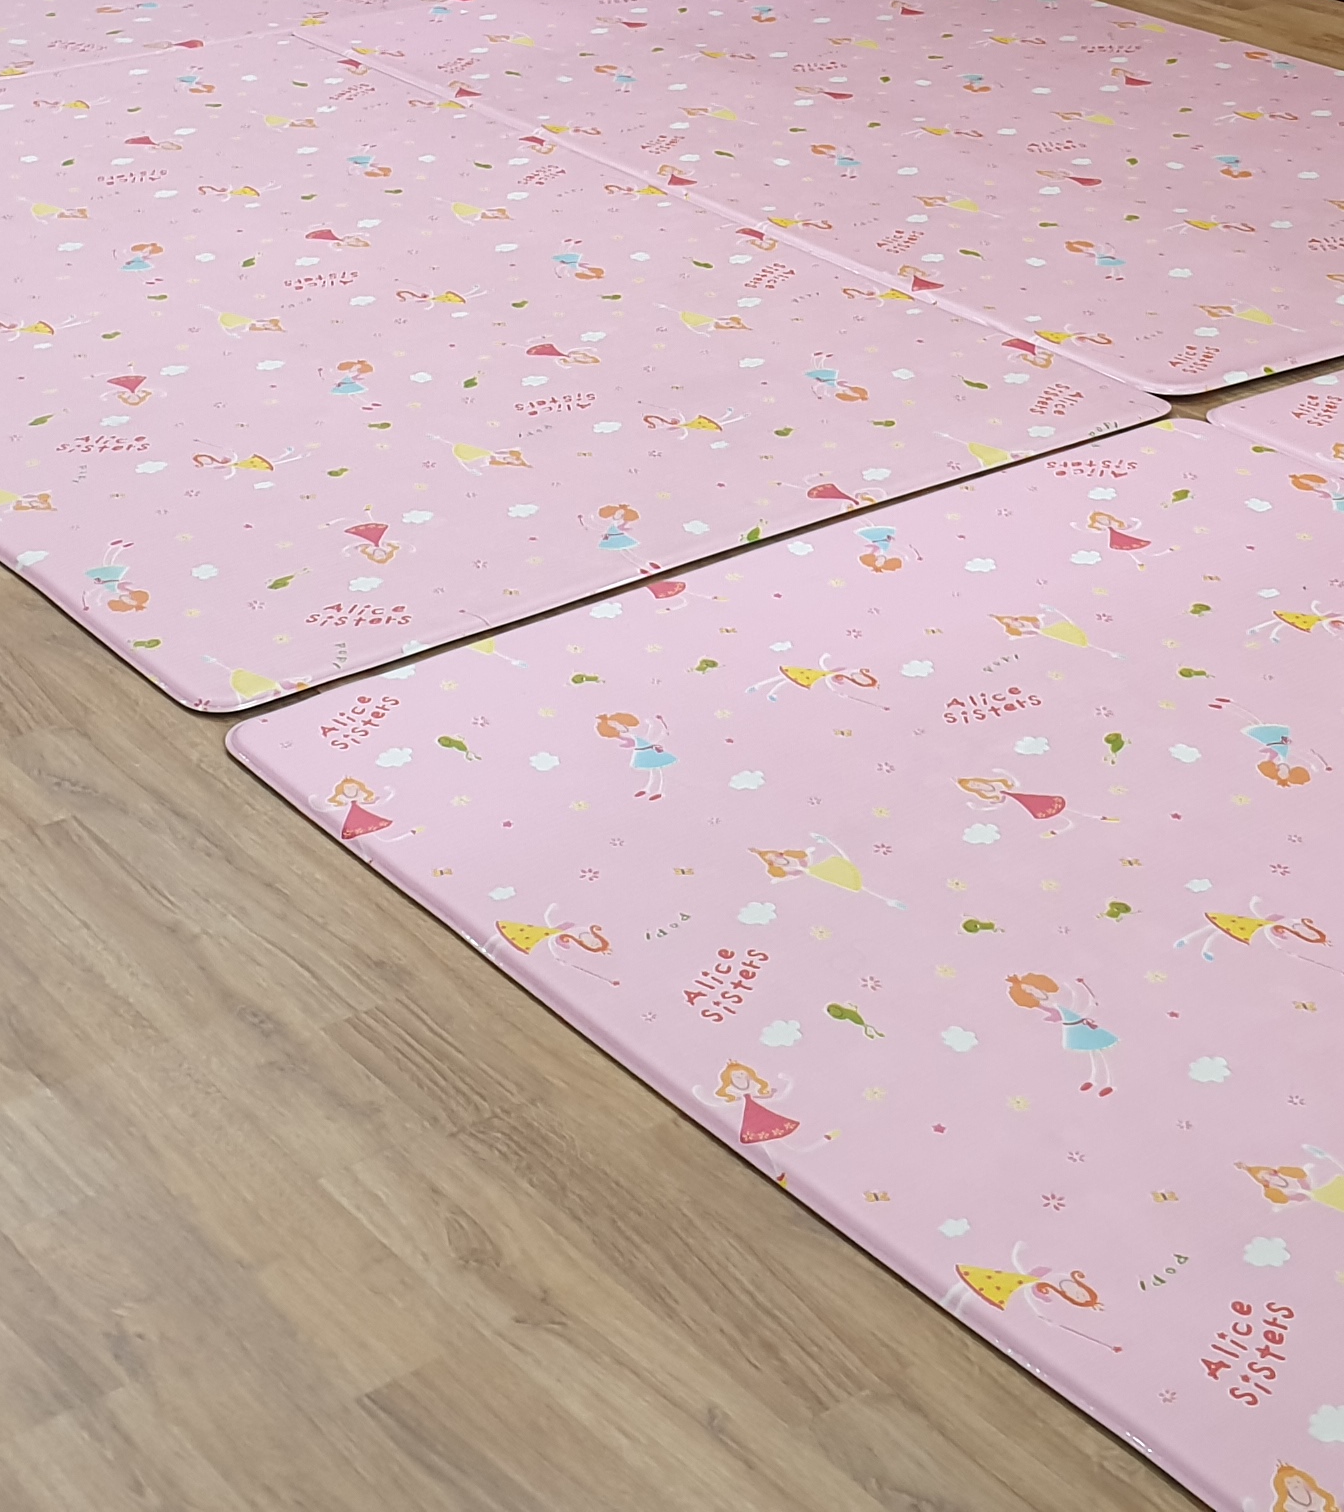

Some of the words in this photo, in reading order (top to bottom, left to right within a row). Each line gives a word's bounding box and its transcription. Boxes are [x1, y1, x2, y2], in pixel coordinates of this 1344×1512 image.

[323, 603, 406, 615] Alice
[320, 696, 372, 738] Alice
[947, 686, 1022, 708] Alice
[684, 948, 735, 1006] Alice
[1200, 1300, 1252, 1381] Alice
